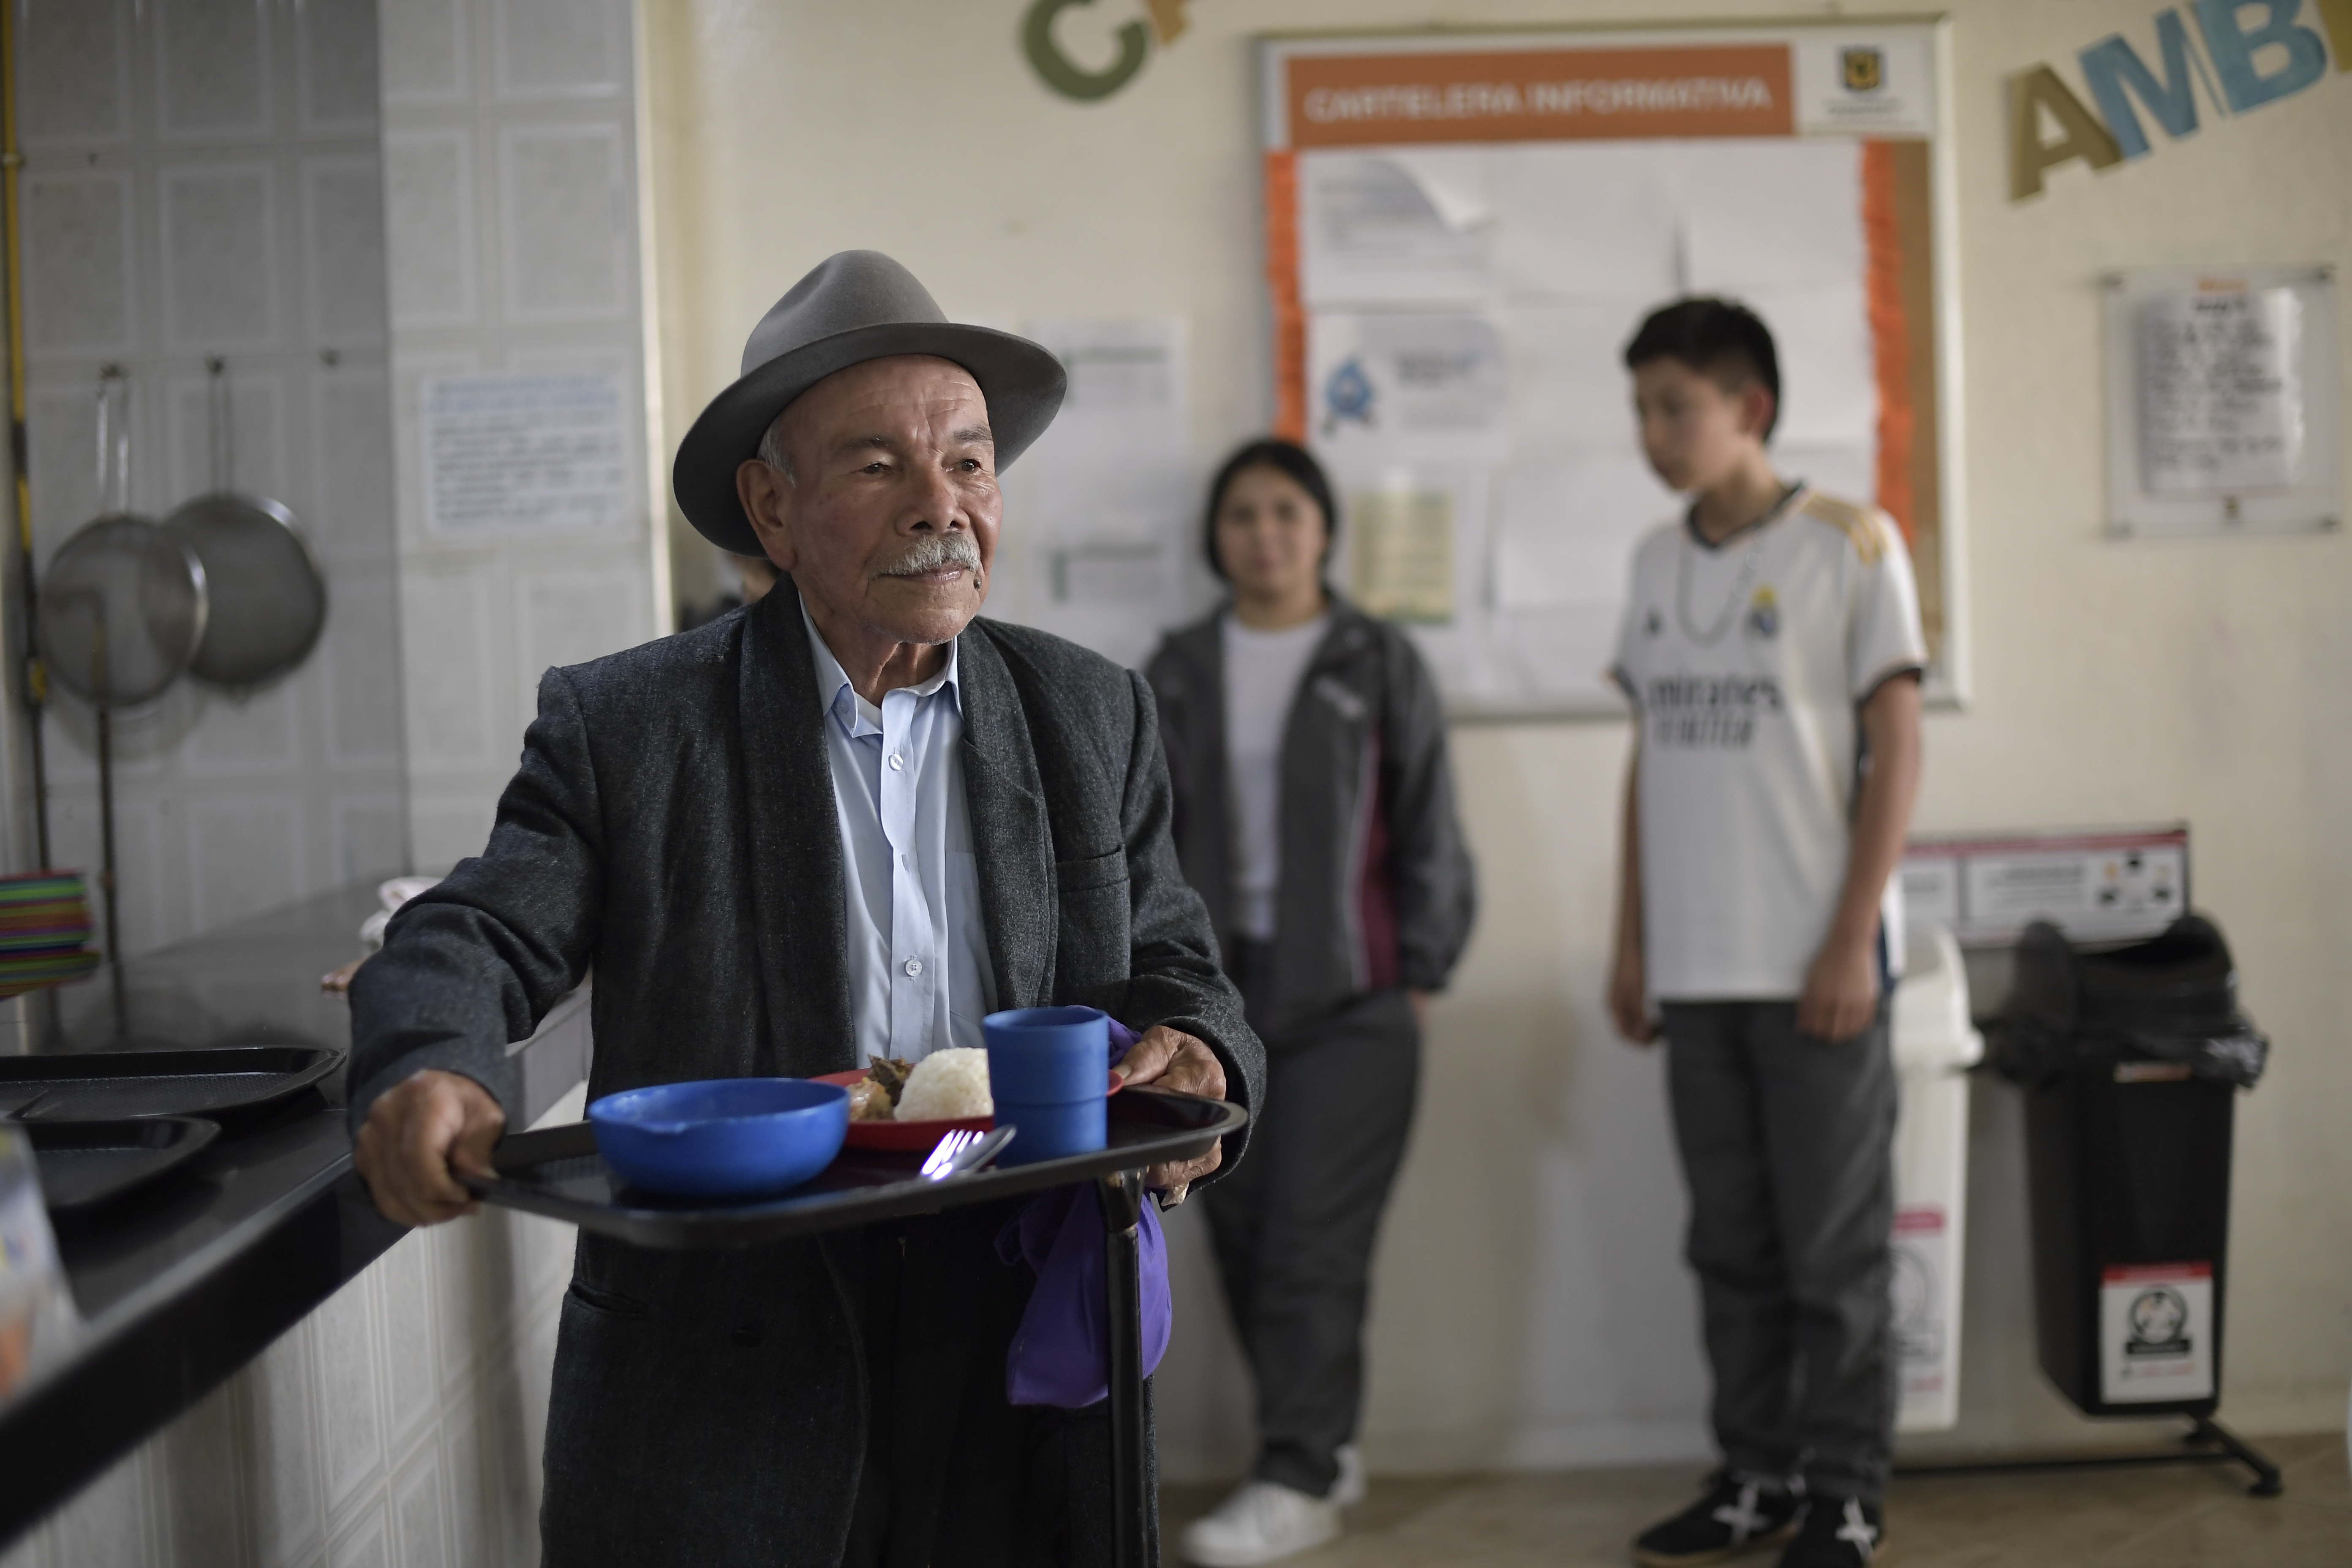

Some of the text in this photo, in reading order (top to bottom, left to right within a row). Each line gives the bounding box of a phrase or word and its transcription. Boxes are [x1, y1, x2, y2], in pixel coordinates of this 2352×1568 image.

[1019, 0, 1189, 101] C
[1304, 83, 1522, 123] CARTELERA
[1527, 77, 1773, 117] INFORMATIVA
